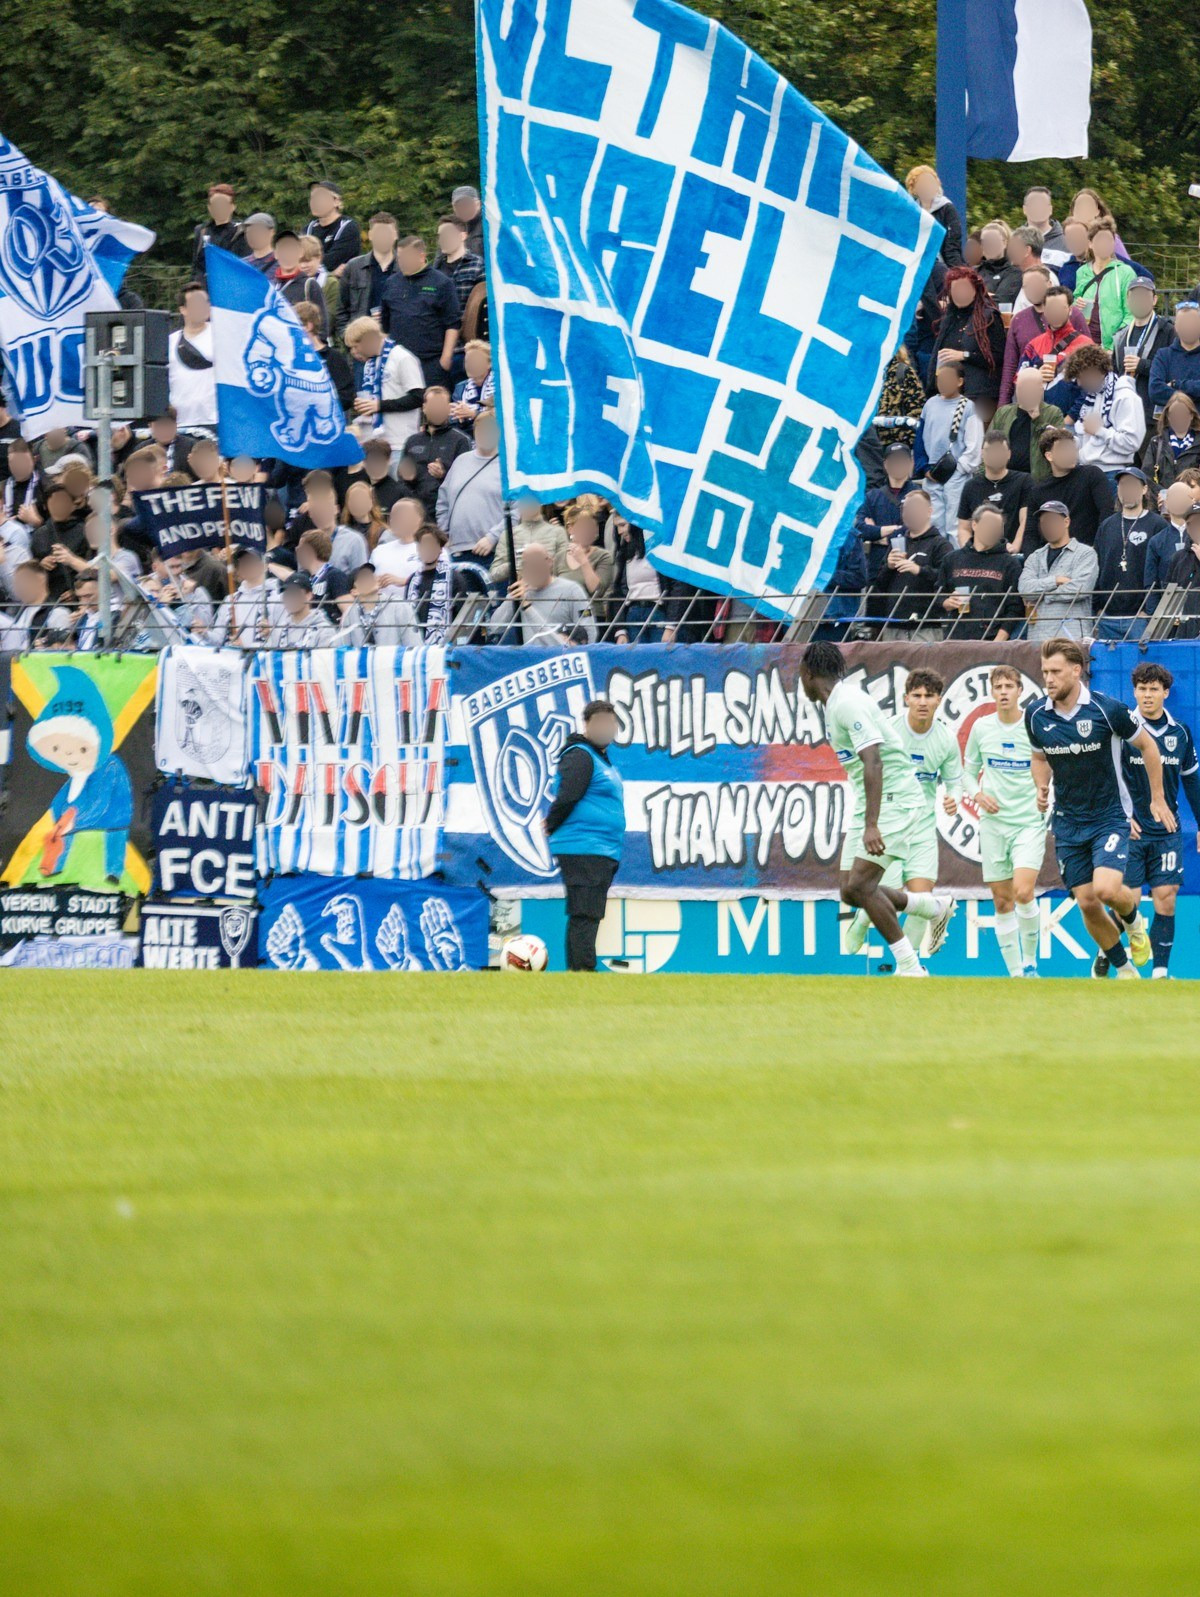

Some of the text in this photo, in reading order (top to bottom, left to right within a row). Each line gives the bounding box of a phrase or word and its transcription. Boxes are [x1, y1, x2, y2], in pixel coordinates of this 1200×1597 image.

[140, 486, 261, 515] THE FEW
[158, 519, 264, 546] AND PROUD
[469, 656, 585, 717] BABELSBERG
[250, 678, 452, 747] VIVA LA
[1081, 742, 1102, 753] Liebe
[1130, 756, 1180, 765] Pots Liebe
[254, 761, 446, 827] DATSCHA
[159, 800, 256, 841] ANTI
[643, 782, 844, 870] THAN YOU
[1104, 833, 1120, 852] 8
[160, 847, 257, 899] FCE
[1161, 851, 1177, 872] 10
[143, 916, 198, 945] ALTE
[143, 946, 221, 969] WERTE
